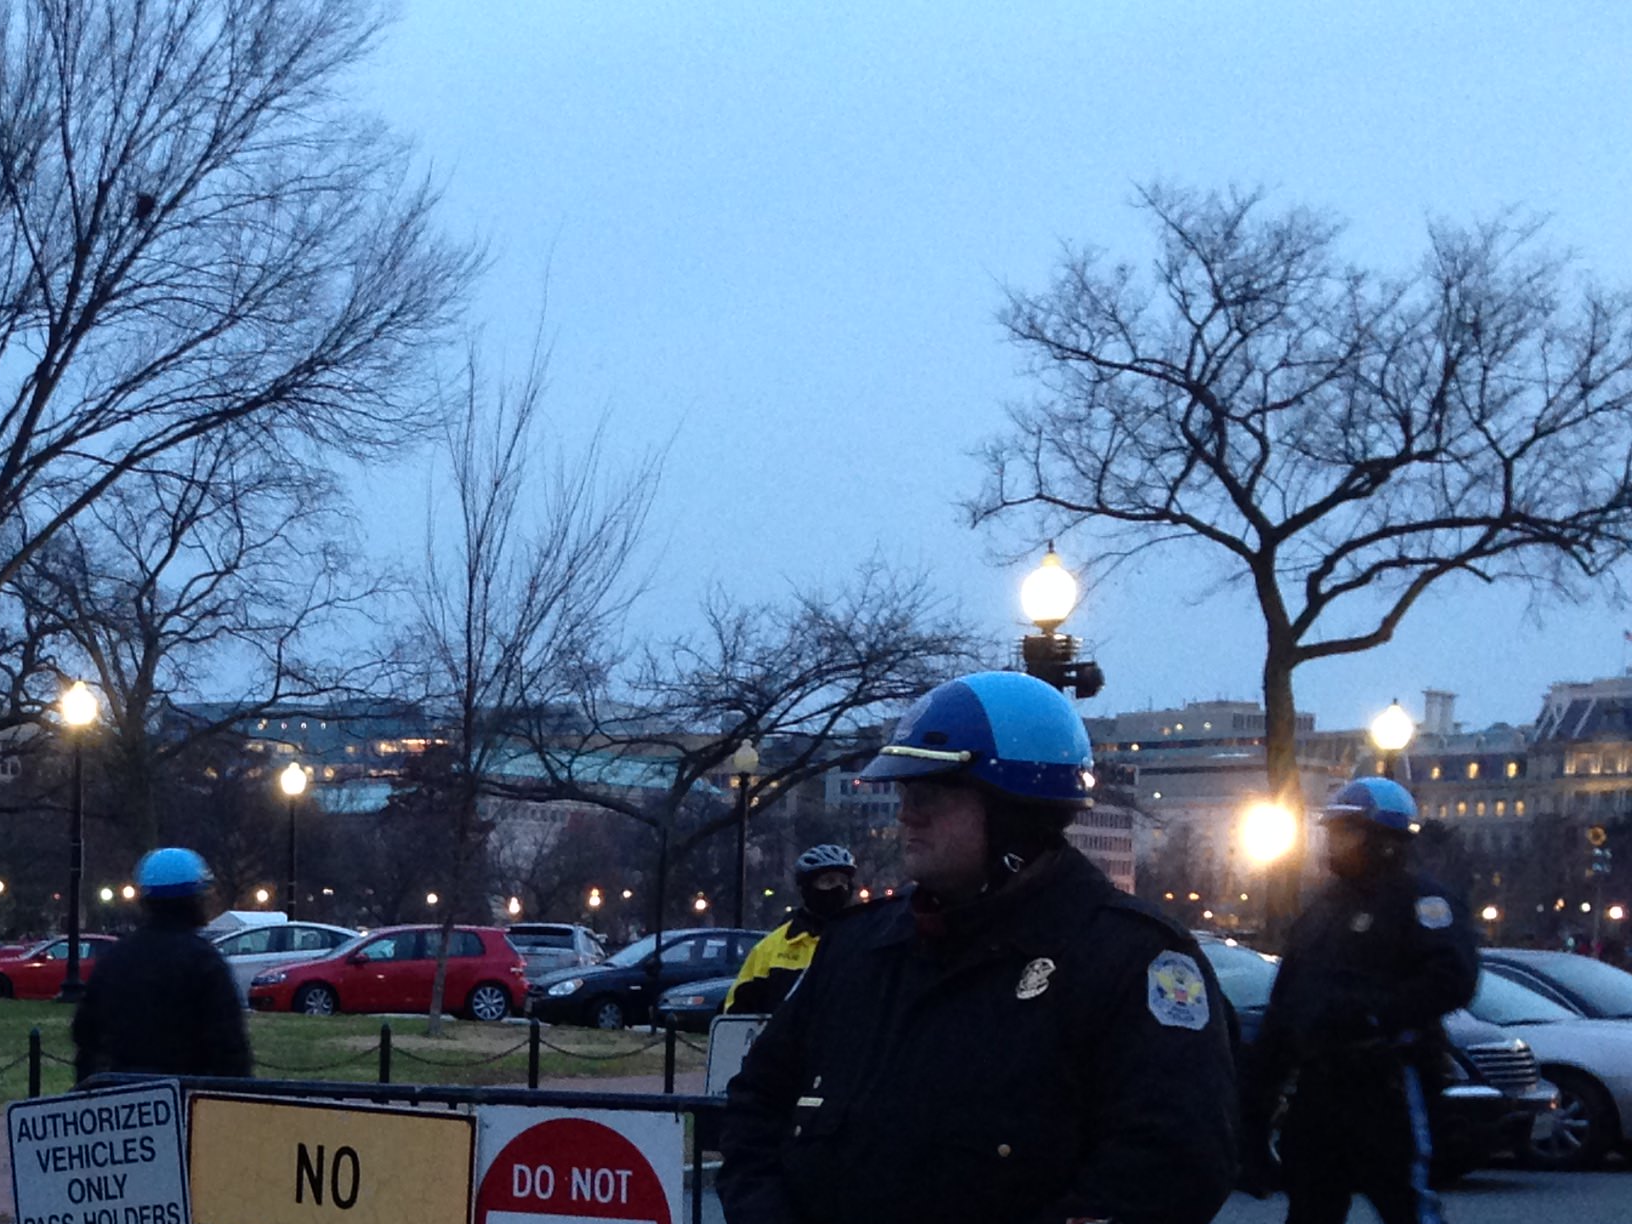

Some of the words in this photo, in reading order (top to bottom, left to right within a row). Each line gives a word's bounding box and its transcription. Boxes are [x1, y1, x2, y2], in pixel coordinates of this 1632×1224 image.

[17, 1100, 171, 1142] AUTHORIZED
[36, 1136, 156, 1173] VEHICLES
[67, 1173, 127, 1204] ONLY
[295, 1142, 360, 1209] NO
[512, 1163, 555, 1200] DO
[571, 1166, 633, 1204] NOT
